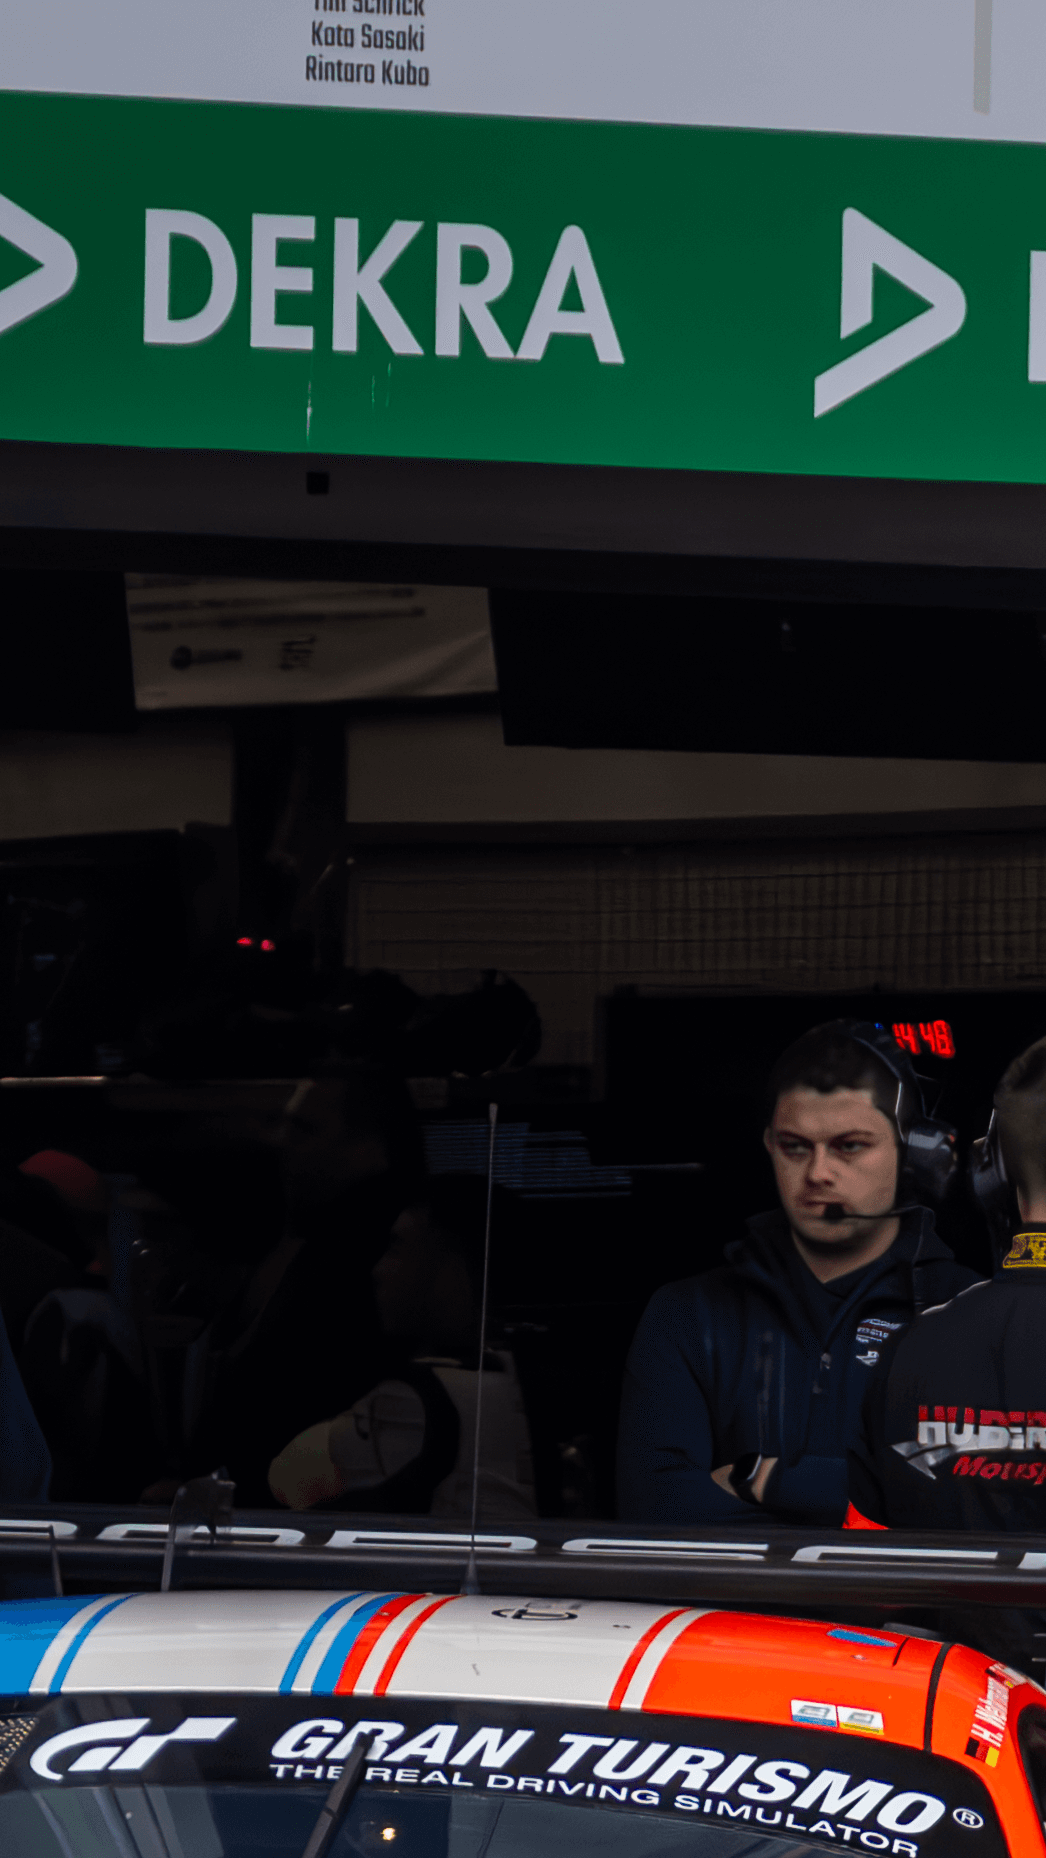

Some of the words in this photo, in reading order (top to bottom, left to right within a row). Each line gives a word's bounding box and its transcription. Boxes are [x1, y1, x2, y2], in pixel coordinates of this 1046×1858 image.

[361, 23, 425, 52] Sasaki
[381, 58, 430, 87] Kubo
[143, 207, 626, 364] DEKRA
[269, 1717, 536, 1770] GRAN
[547, 1732, 948, 1834] TURISMO
[364, 1767, 474, 1788] REAL
[485, 1774, 661, 1807] DRIVING
